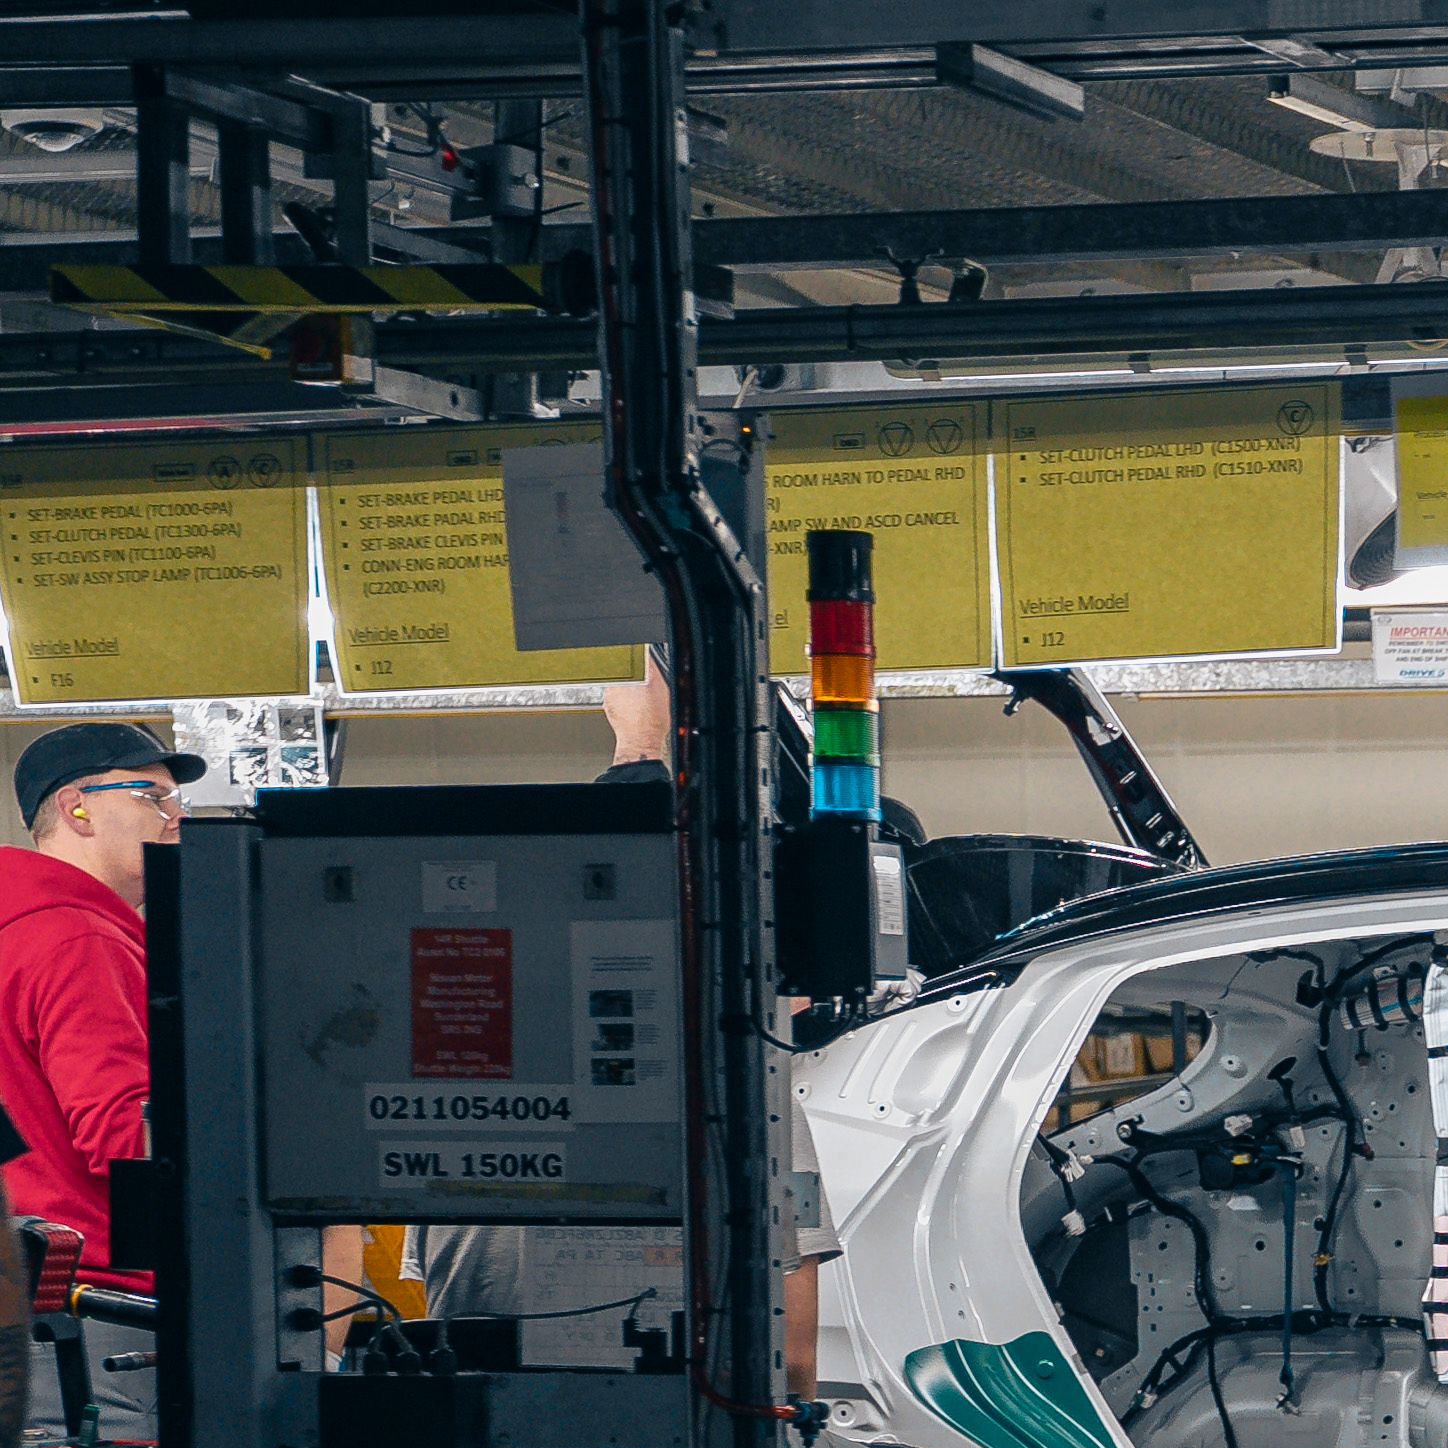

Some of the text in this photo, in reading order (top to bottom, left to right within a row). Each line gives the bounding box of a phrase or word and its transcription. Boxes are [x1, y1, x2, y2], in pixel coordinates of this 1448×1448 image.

[1039, 448, 1124, 465] SET-CLUTCH
[1127, 444, 1172, 460] PEDAL
[1175, 442, 1204, 458] LHD
[773, 474, 819, 489] ROOM
[822, 471, 860, 487] HARN
[866, 470, 885, 485] TO
[888, 469, 932, 484] PEDAL
[935, 466, 967, 481] RHD
[1039, 459, 1304, 487] SET-CLUTCH PEDAL RHD (C1510-XNR)
[358, 493, 430, 509] SET-BRAKE
[433, 492, 474, 506] PEDAL
[27, 507, 98, 522] SET-BRAKE
[101, 505, 143, 520] PEDAL
[358, 515, 431, 530] SET-BRAKE
[433, 514, 475, 528] PADAL
[768, 519, 802, 534] AMP
[831, 515, 862, 530] AND
[905, 511, 960, 527] CANCEL
[28, 528, 107, 544] SET-CLUTCH
[110, 526, 151, 541] PEDAL
[360, 533, 504, 553] SET-BRAKE CLEVIS PIN
[30, 549, 100, 566] SET-CLEVIS
[103, 548, 126, 563] PIN
[361, 559, 434, 574] CONN-ENG
[437, 556, 480, 571] ROOM
[32, 572, 80, 588] SET-SW
[82, 571, 114, 585] ASSY
[116, 570, 149, 584] STOP
[153, 568, 192, 583] LAMP
[1019, 592, 1129, 615] Vehicle Model
[348, 623, 450, 643] Vehicle Model
[25, 637, 119, 656] Vehicle Model
[369, 1095, 571, 1122] 0211054004
[384, 1152, 563, 1179] SWL 150KG
